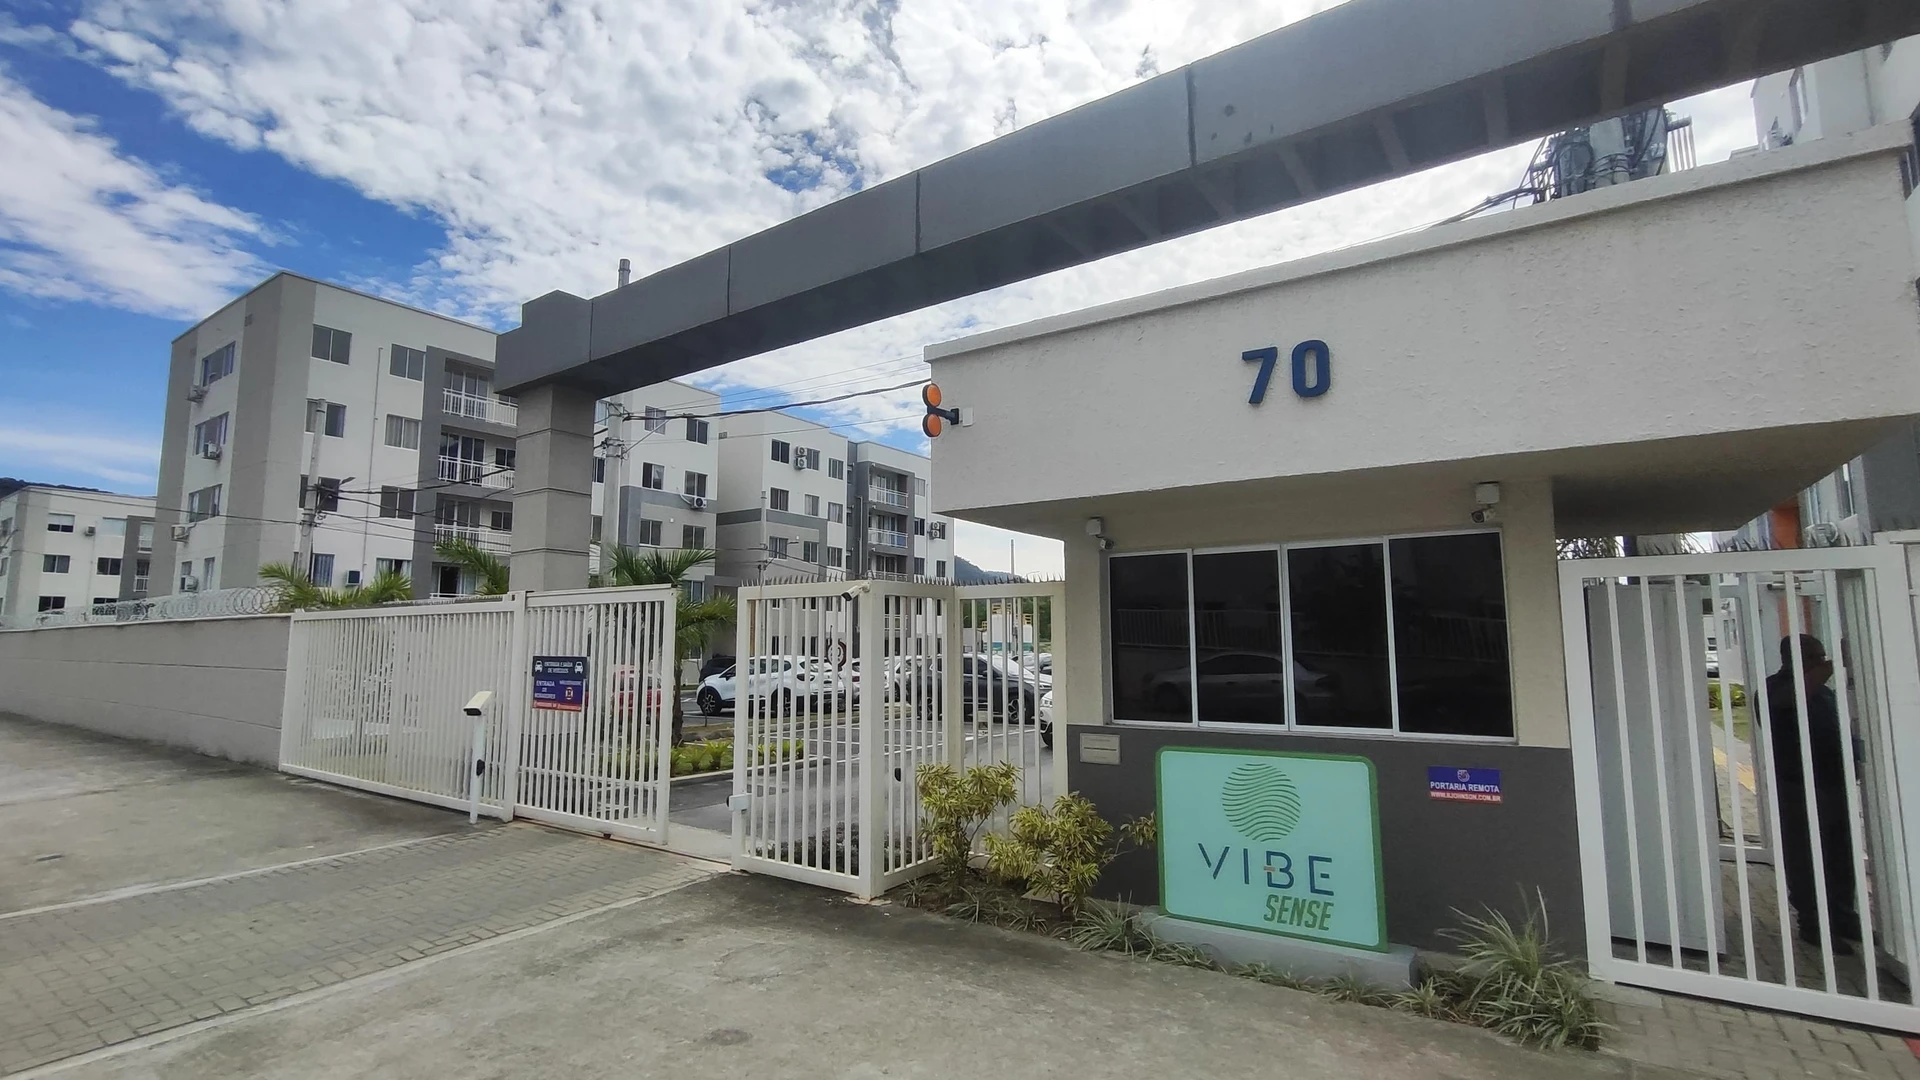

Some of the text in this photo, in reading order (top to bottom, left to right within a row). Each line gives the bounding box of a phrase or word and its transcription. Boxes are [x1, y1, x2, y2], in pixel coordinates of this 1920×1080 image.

[1242, 340, 1331, 404] 70
[1430, 781, 1500, 793] PORTARIA REMOTA
[1198, 843, 1334, 896] VIBE
[1263, 894, 1334, 931] SENSE
